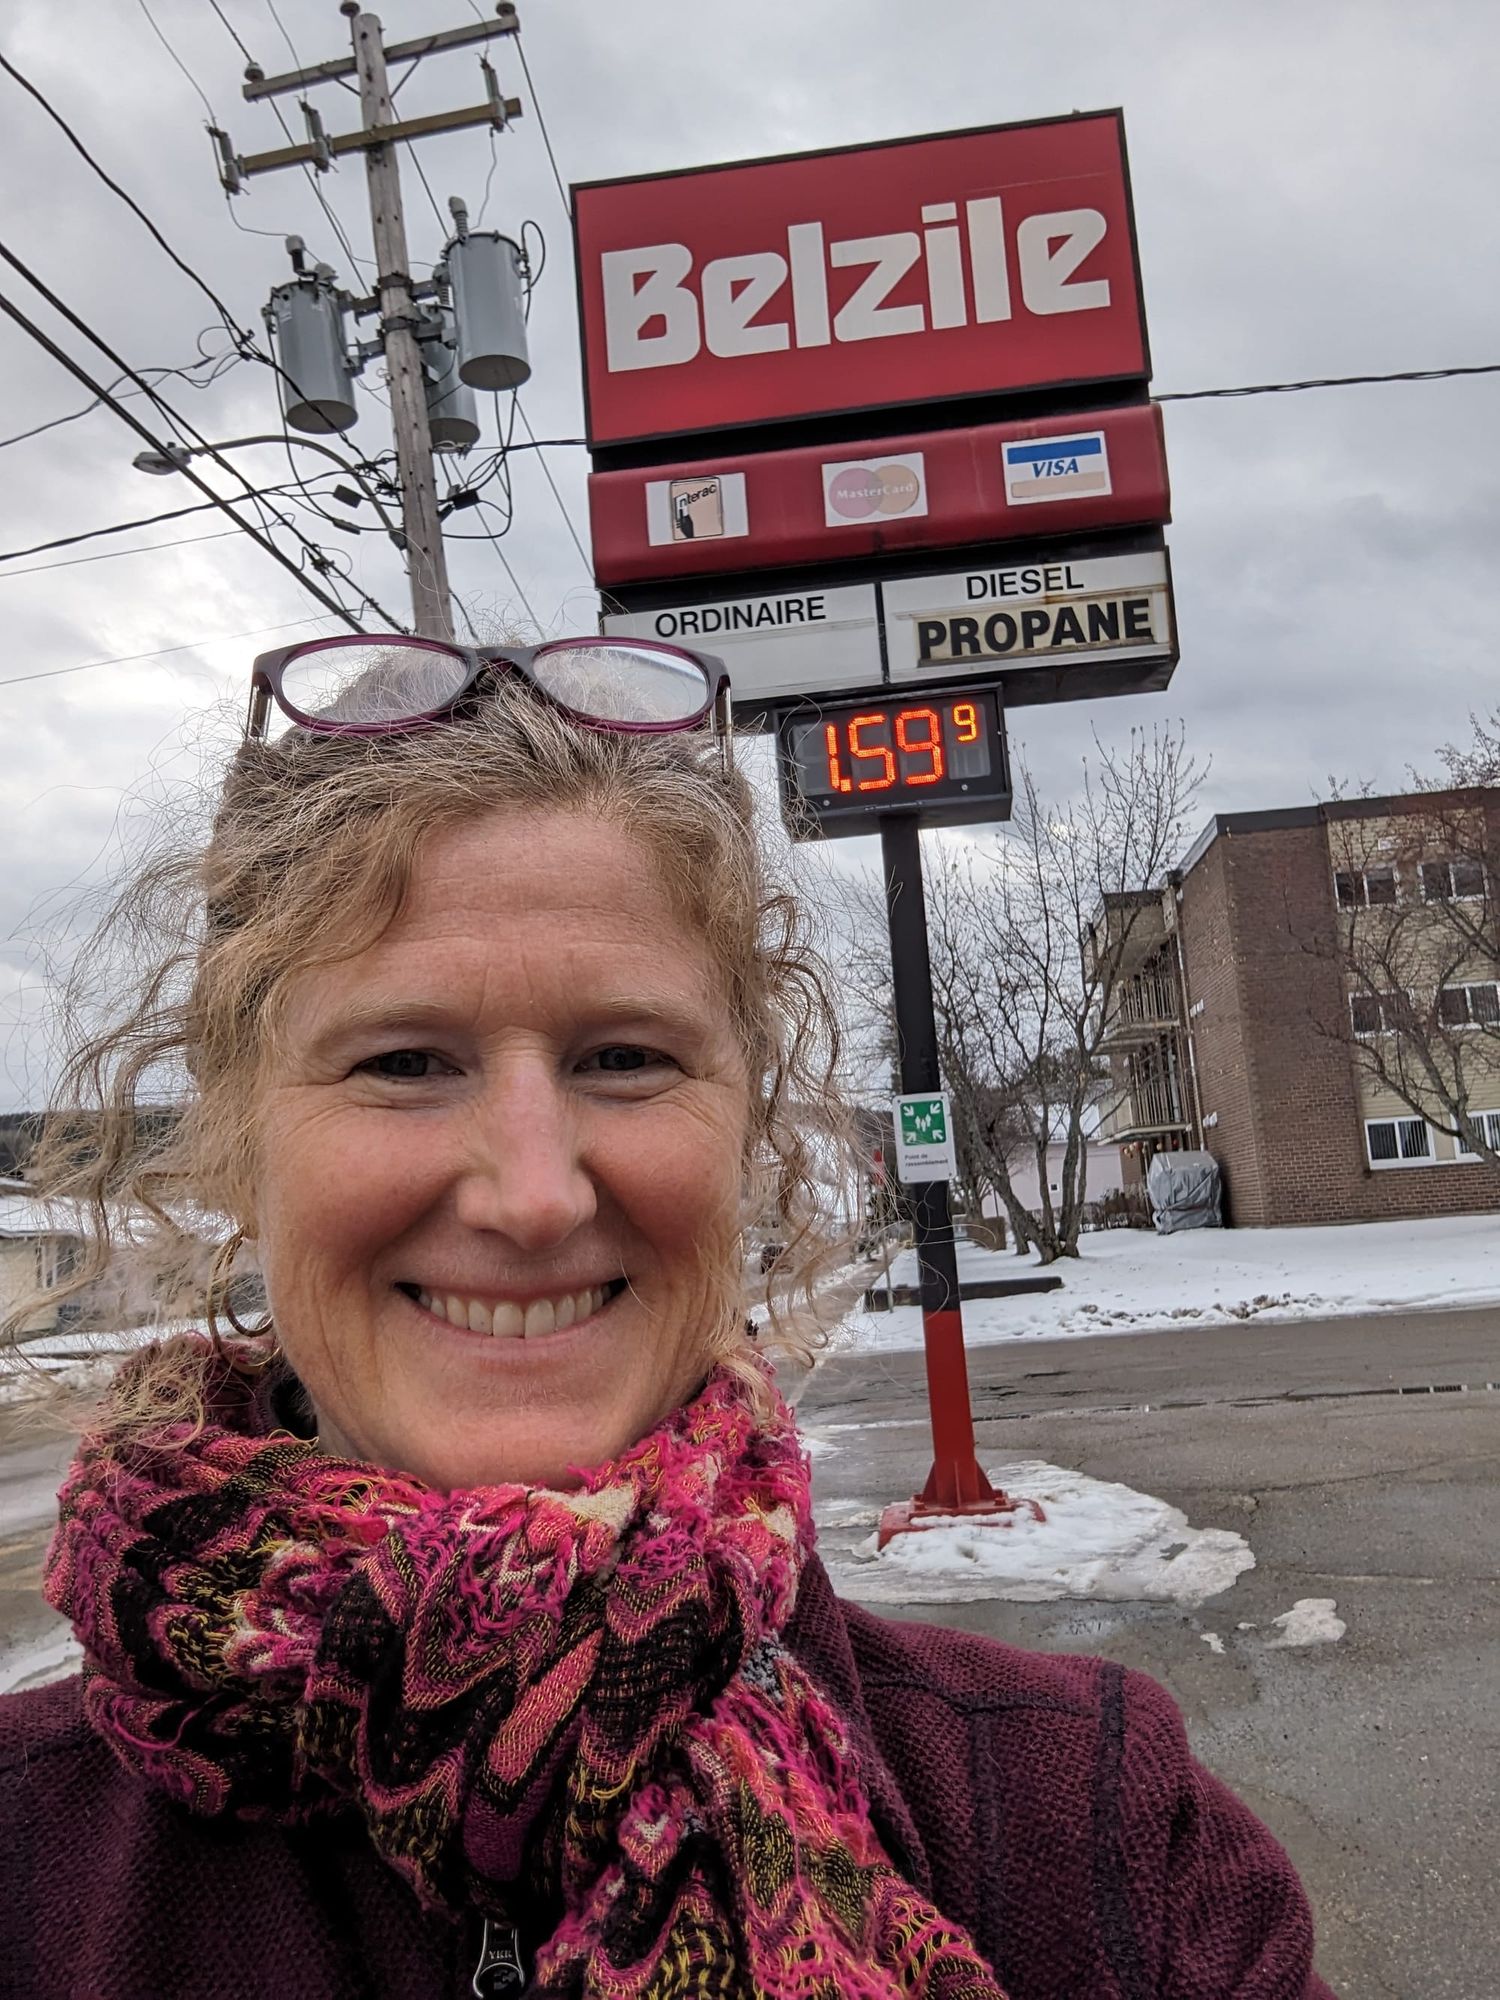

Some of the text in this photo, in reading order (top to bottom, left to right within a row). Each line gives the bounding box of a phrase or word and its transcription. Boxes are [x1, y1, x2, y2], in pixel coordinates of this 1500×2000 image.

[600, 196, 1111, 373] Belzile
[1032, 458, 1079, 478] VISA
[837, 483, 915, 499] MasterCard
[966, 565, 1084, 600] DIESEL
[655, 595, 827, 638] ORDINAIRE
[917, 598, 1154, 660] PROPANE
[489, 1949, 513, 1960] YKK
